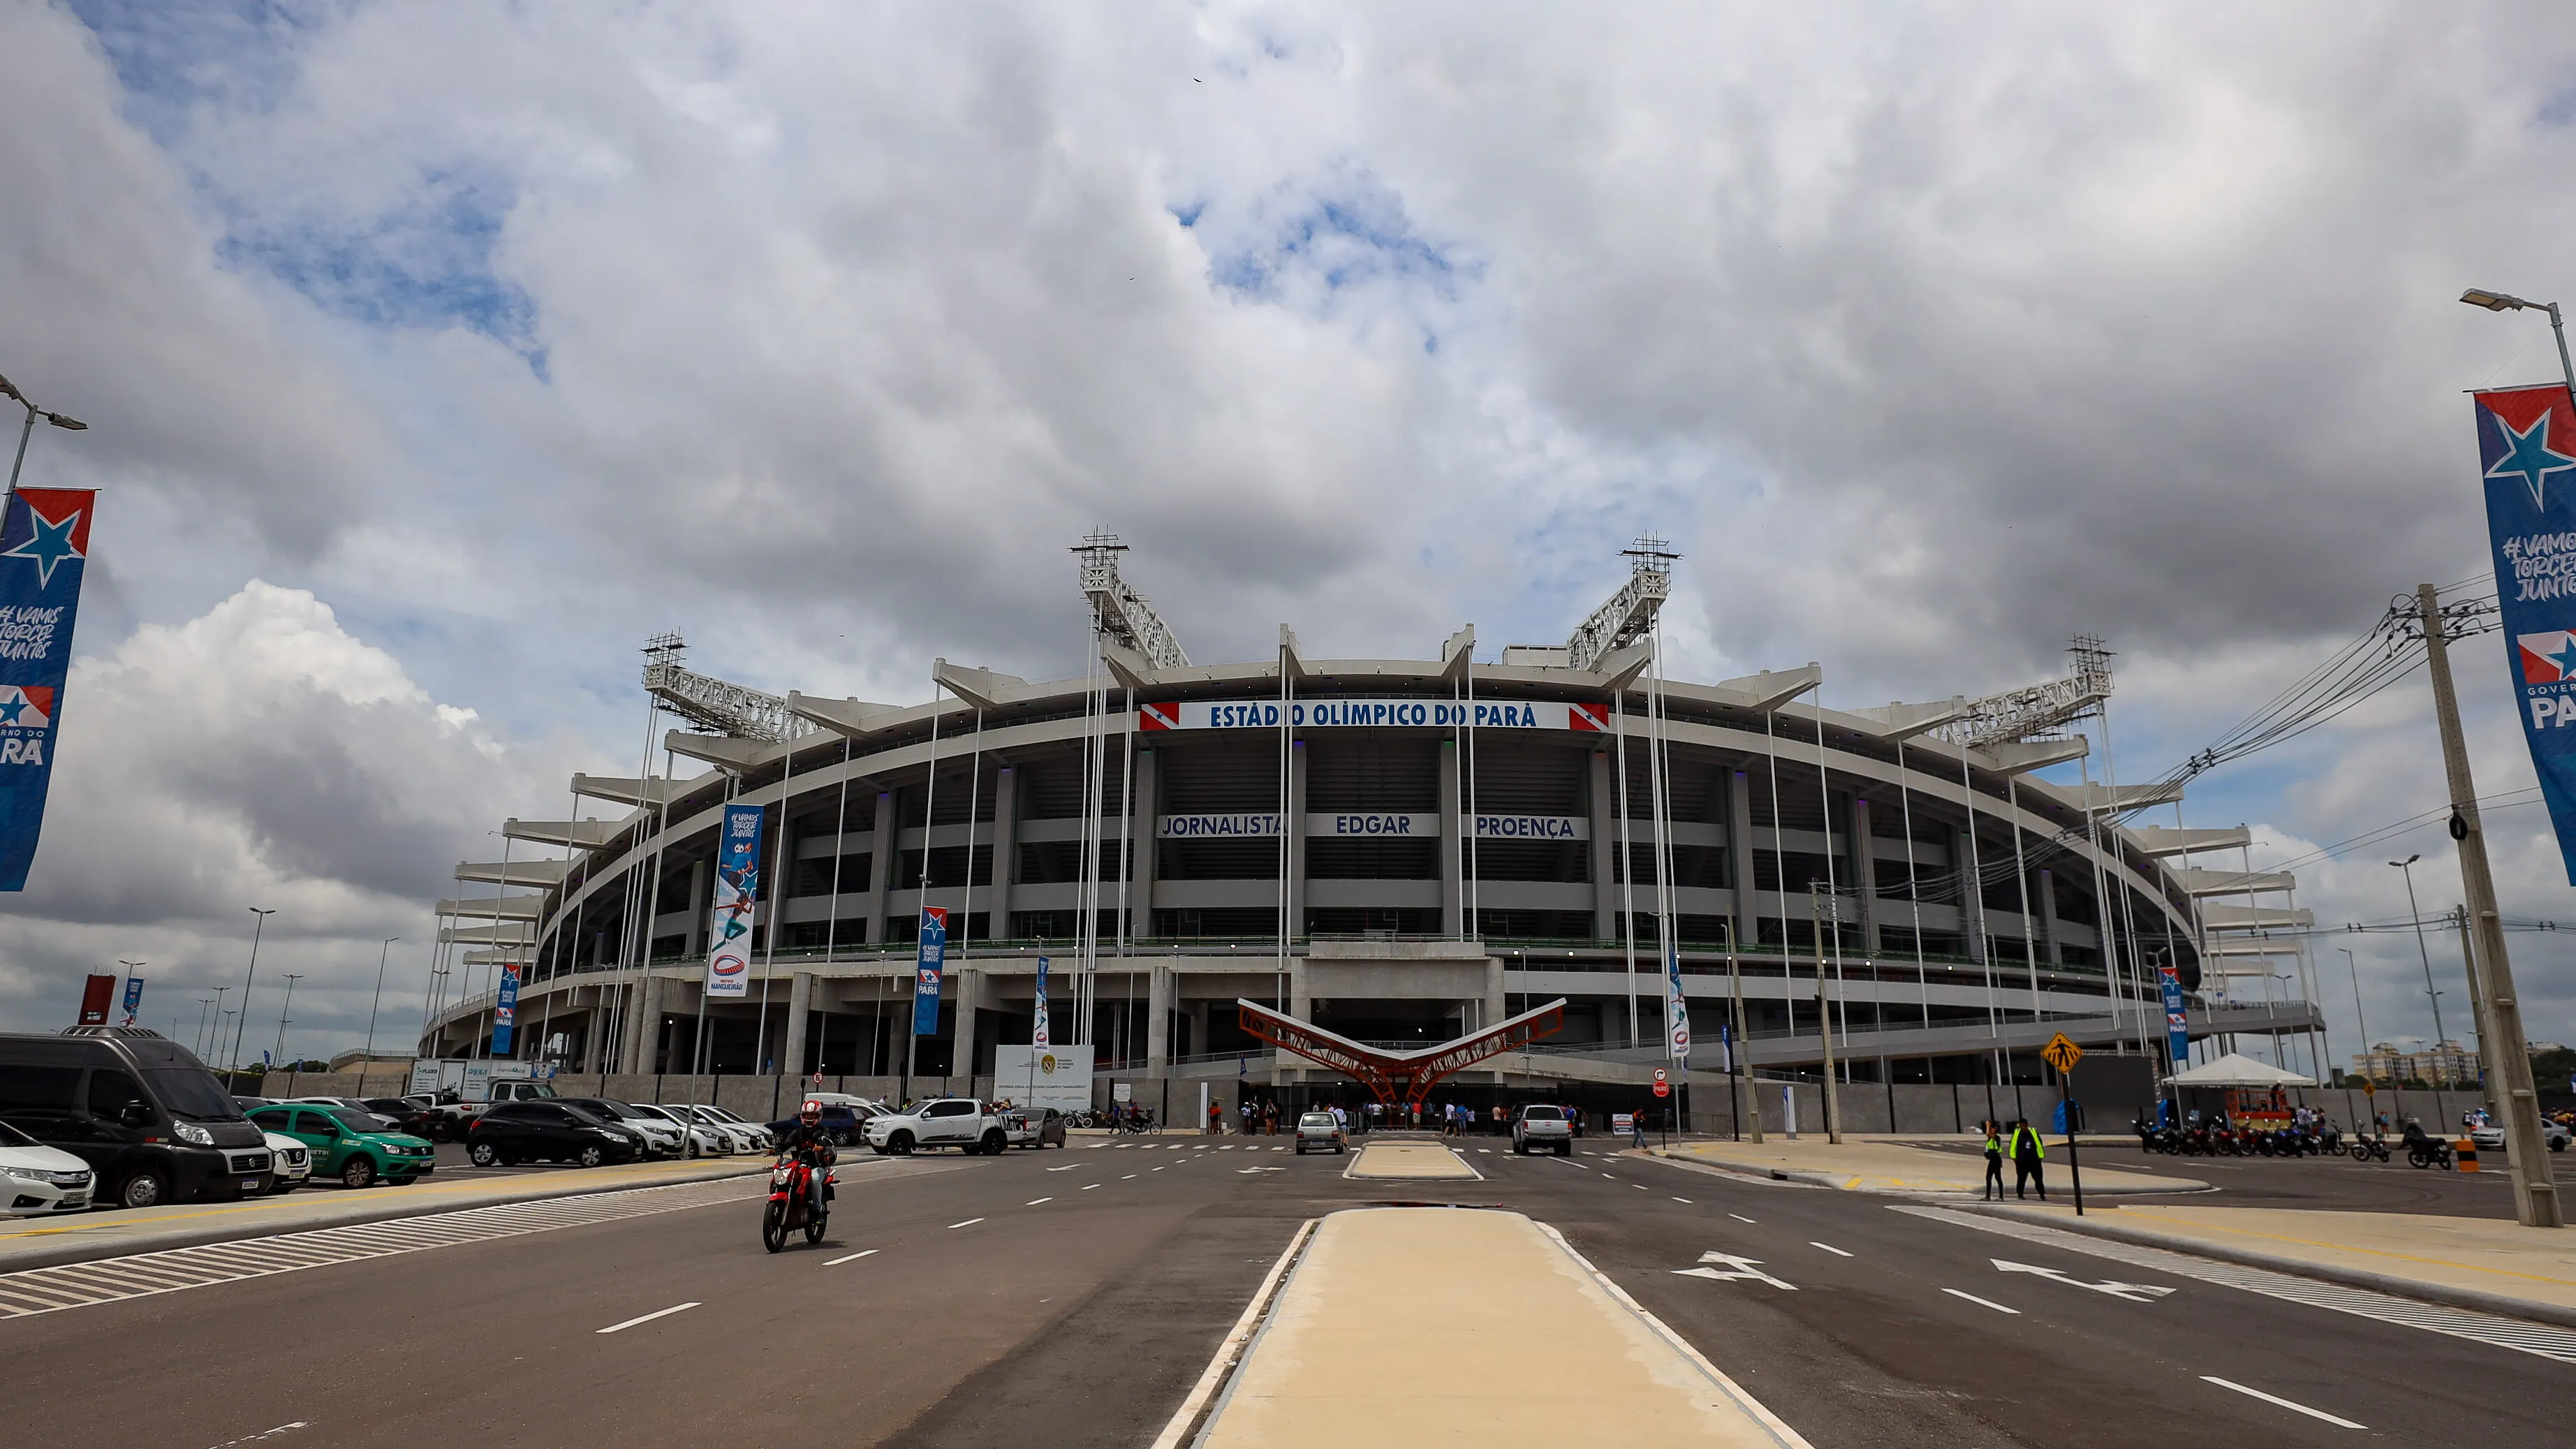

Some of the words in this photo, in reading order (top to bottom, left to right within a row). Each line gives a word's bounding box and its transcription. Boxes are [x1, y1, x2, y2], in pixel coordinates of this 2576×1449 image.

[2511, 552, 2576, 579] TORCE
[1313, 700, 1427, 726] OLÍMPICO
[1435, 704, 1466, 726] DO
[1475, 702, 1536, 727] PARÁ
[731, 813, 759, 822] #VAMOS
[1162, 815, 1288, 836] JORNALISTA
[1336, 816, 1411, 834] EDGAR
[1476, 817, 1575, 839] PROENÇA
[711, 982, 742, 990] MANGUEIRÃO
